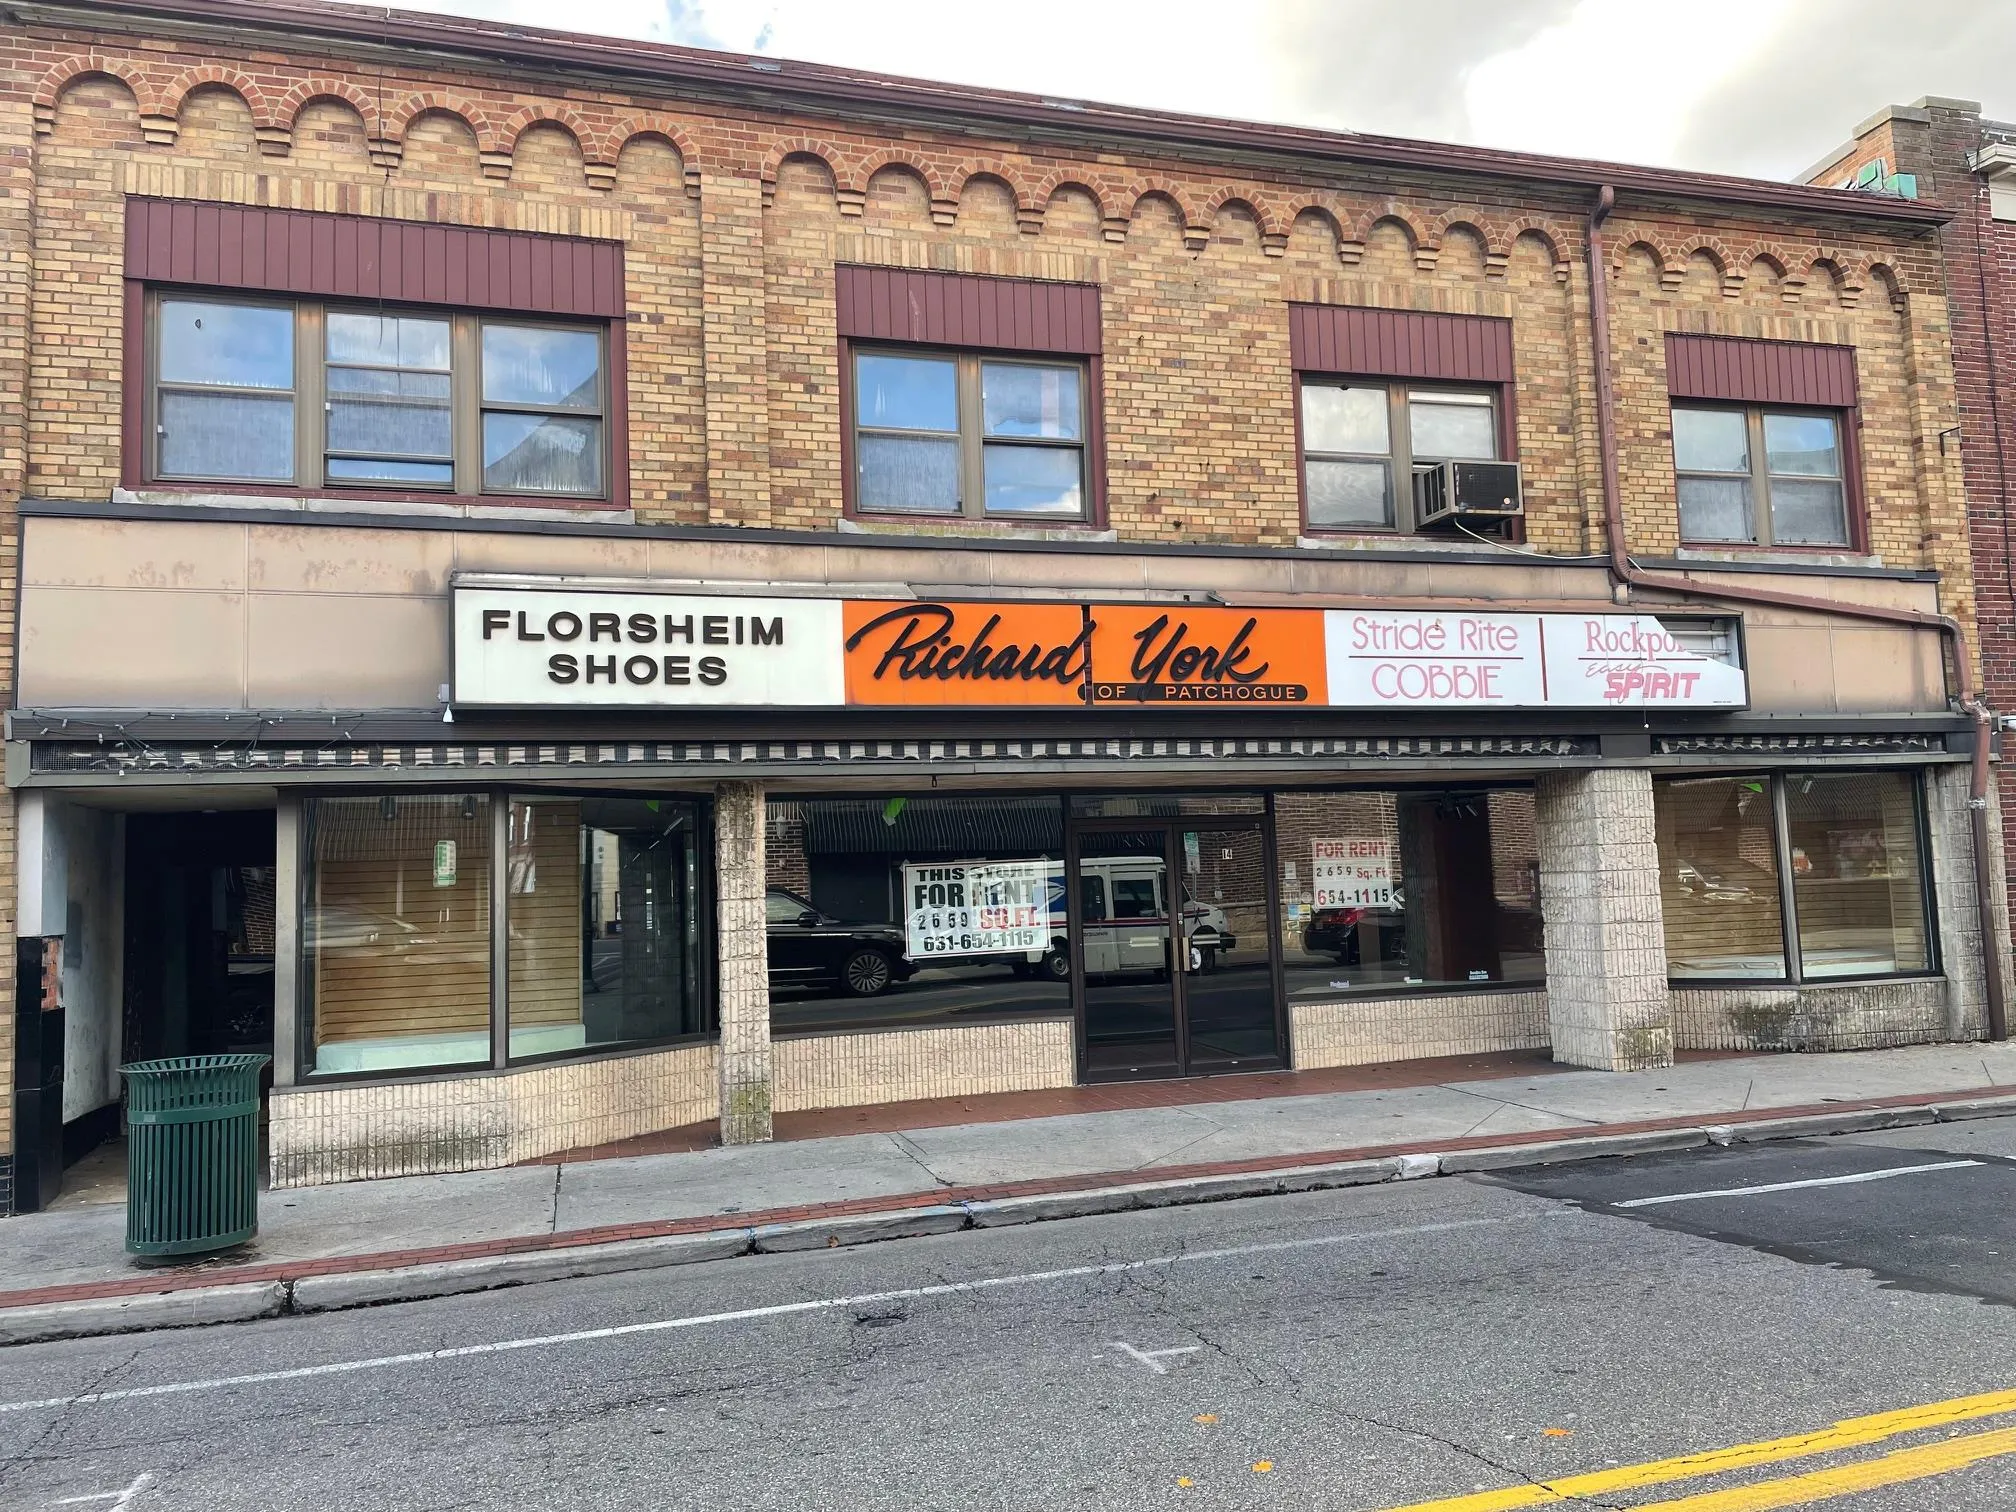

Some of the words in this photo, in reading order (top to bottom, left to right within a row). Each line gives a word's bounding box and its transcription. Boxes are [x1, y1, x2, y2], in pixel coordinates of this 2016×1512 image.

[482, 609, 785, 645] FLORSHEIM
[1352, 616, 1446, 650] Stride
[1459, 618, 1518, 651] Rite
[846, 604, 1097, 684] Richard
[1131, 614, 1269, 702] York
[547, 653, 729, 687] SHOES
[1371, 663, 1503, 699] COBBIE
[1098, 685, 1126, 698] OF
[1165, 686, 1296, 699] PATCHOGUE
[1603, 672, 1700, 699] SPIRIT
[1315, 842, 1344, 858] FOR
[1350, 841, 1388, 858] RENT
[916, 867, 965, 882] THIS
[915, 883, 965, 909] FOR
[972, 879, 1037, 907] RENT
[1317, 888, 1389, 906] 654-1115
[923, 930, 1034, 952] 631-654-1115
